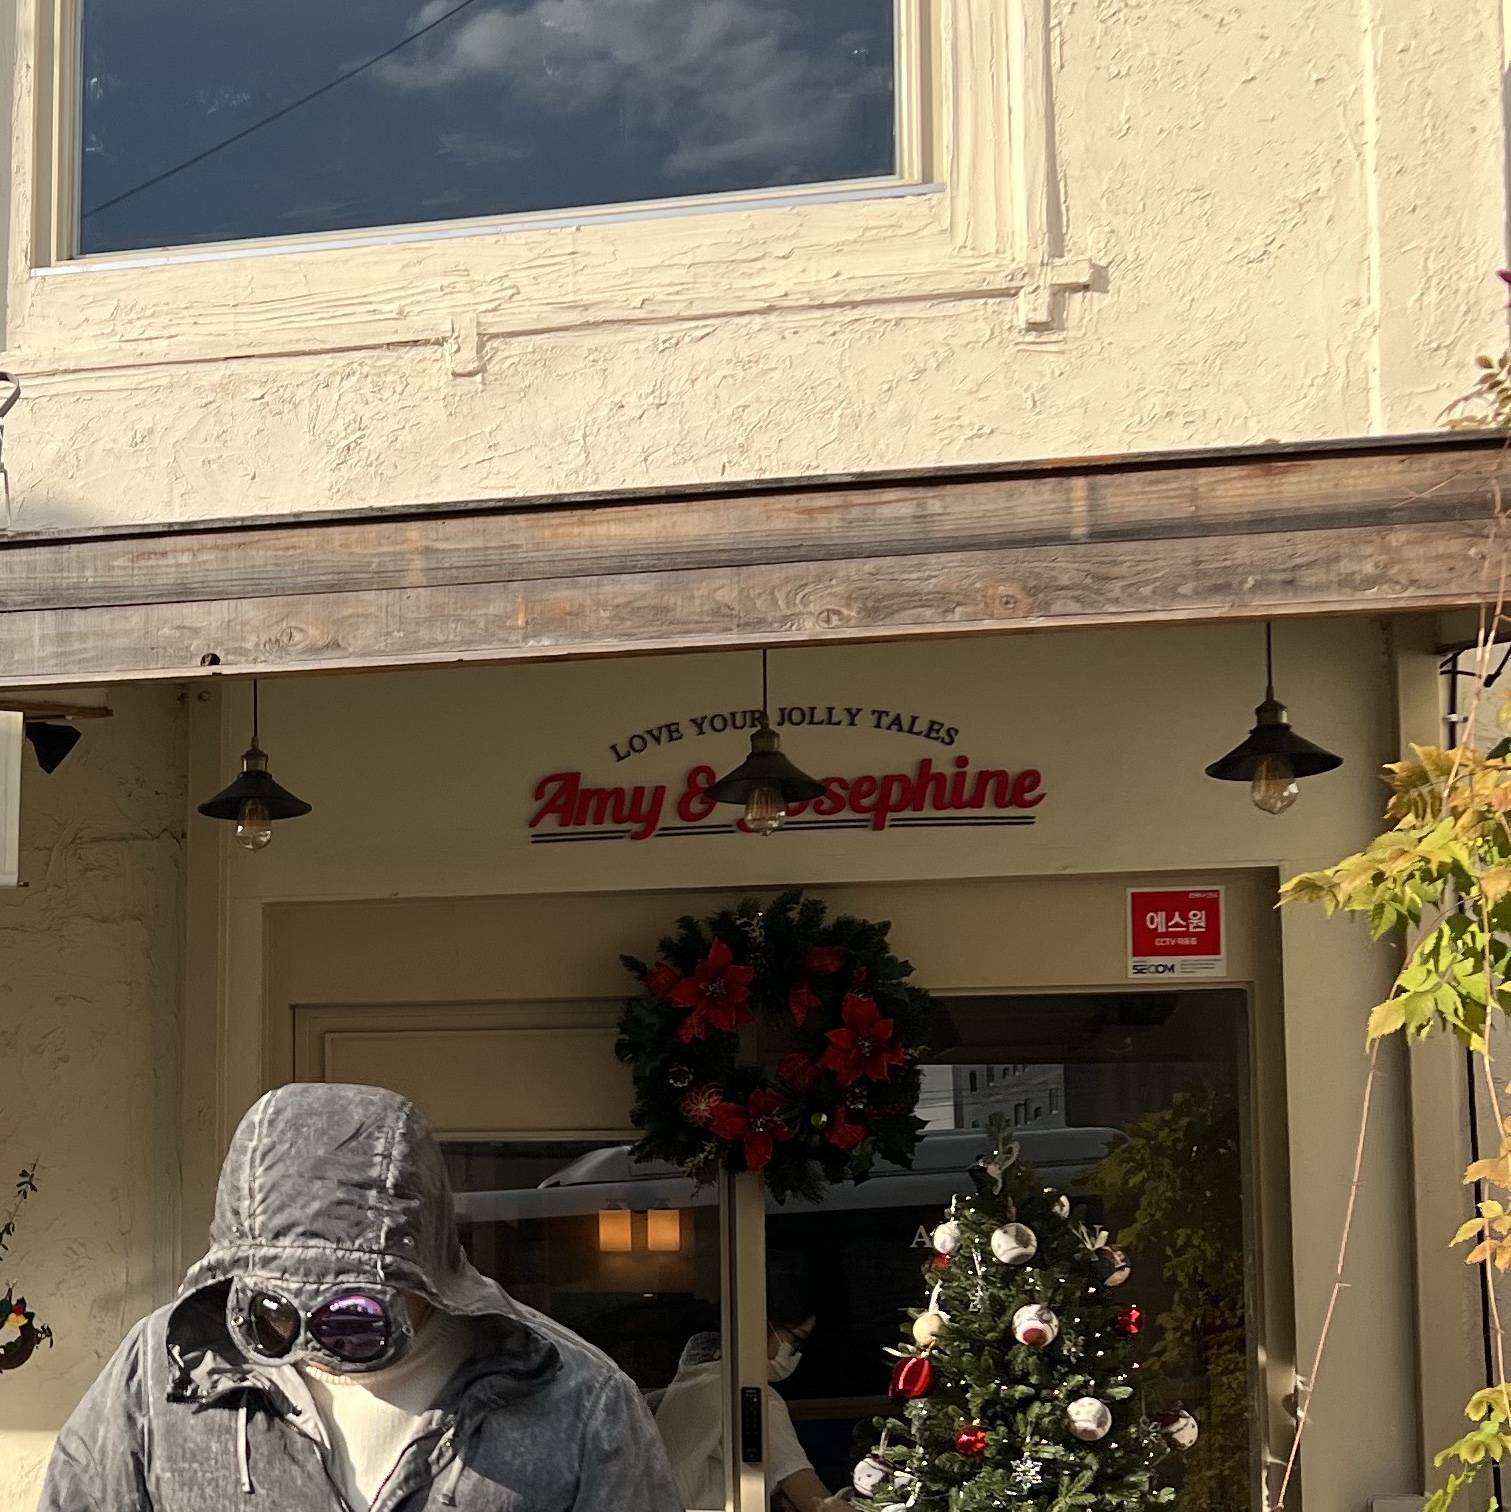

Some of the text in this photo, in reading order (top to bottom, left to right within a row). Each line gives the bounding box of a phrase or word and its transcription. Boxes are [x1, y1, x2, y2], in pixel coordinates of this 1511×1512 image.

[609, 706, 959, 762] LOVE YOUR JOLLY TALES
[529, 755, 1047, 840] Amy & sephine
[1145, 910, 1206, 932] 에스원
